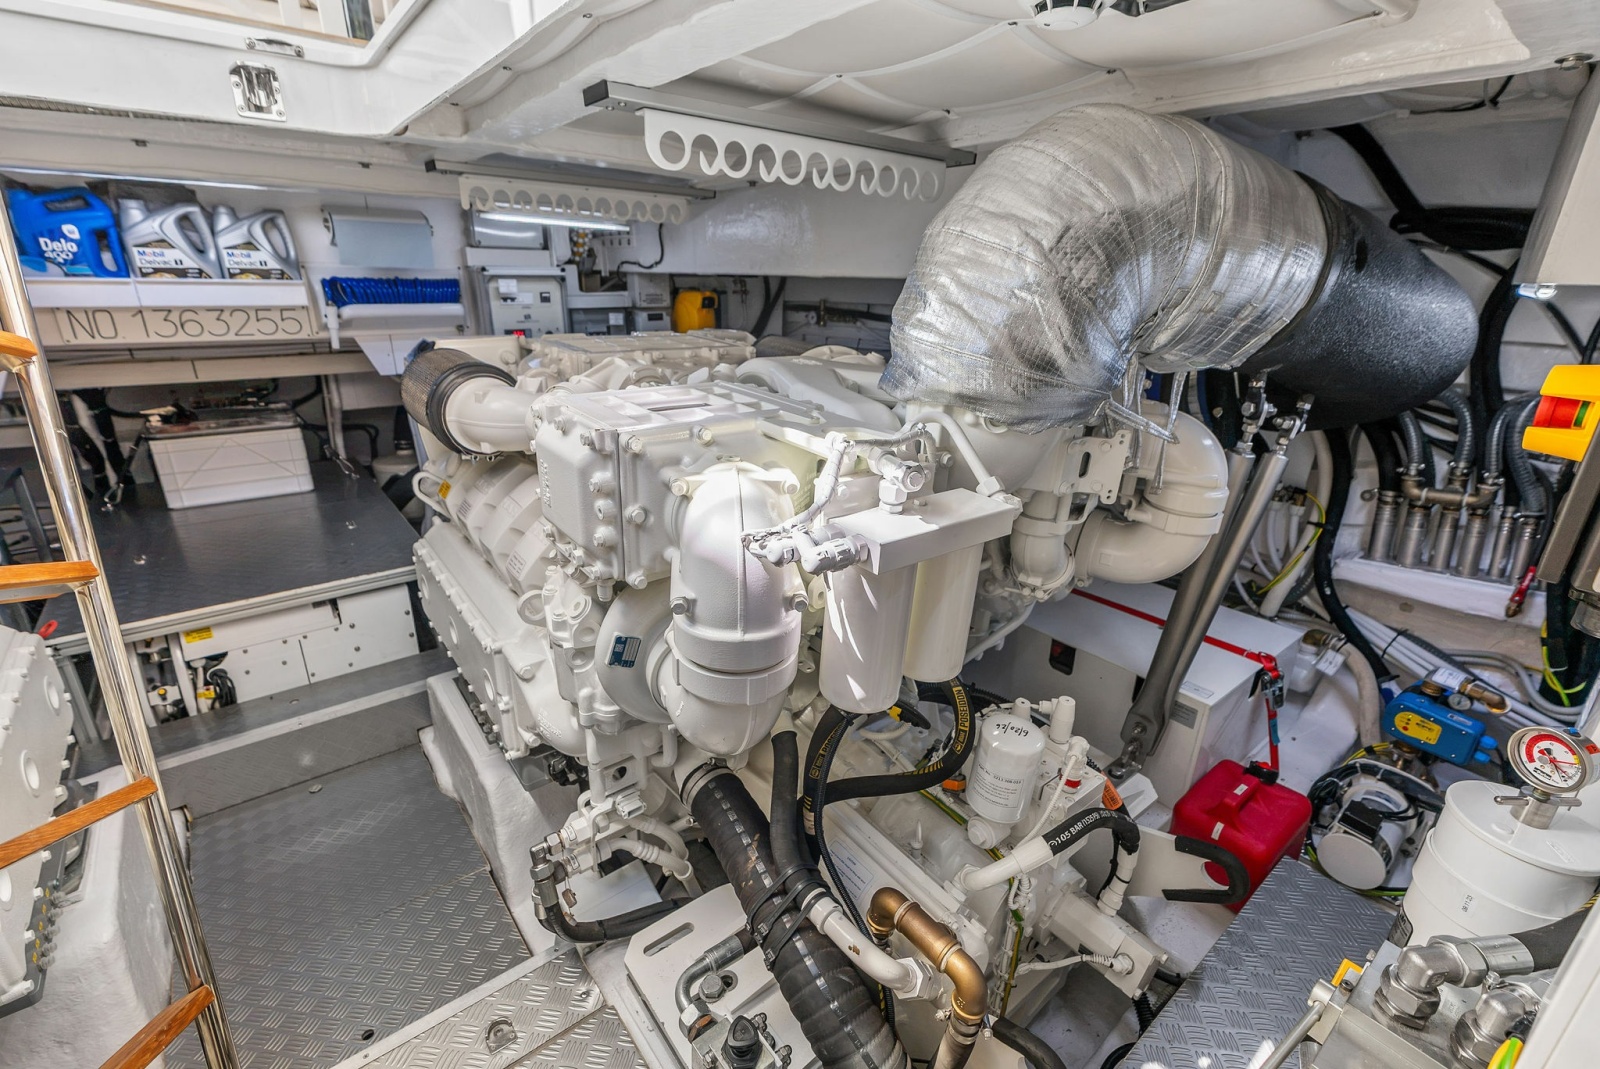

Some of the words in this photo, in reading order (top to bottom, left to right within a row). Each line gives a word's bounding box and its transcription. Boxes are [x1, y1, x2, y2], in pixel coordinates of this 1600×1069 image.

[38, 237, 78, 253] Delo
[137, 249, 165, 258] Mobil
[139, 257, 172, 266] Delvac
[226, 251, 252, 259] Mobil
[228, 259, 257, 267] Delvac
[131, 308, 303, 338] 1363255
[955, 689, 969, 729] POSEIDON
[995, 721, 1029, 737] 6/20/26
[1055, 830, 1071, 844] 105
[1069, 820, 1084, 835] BAR
